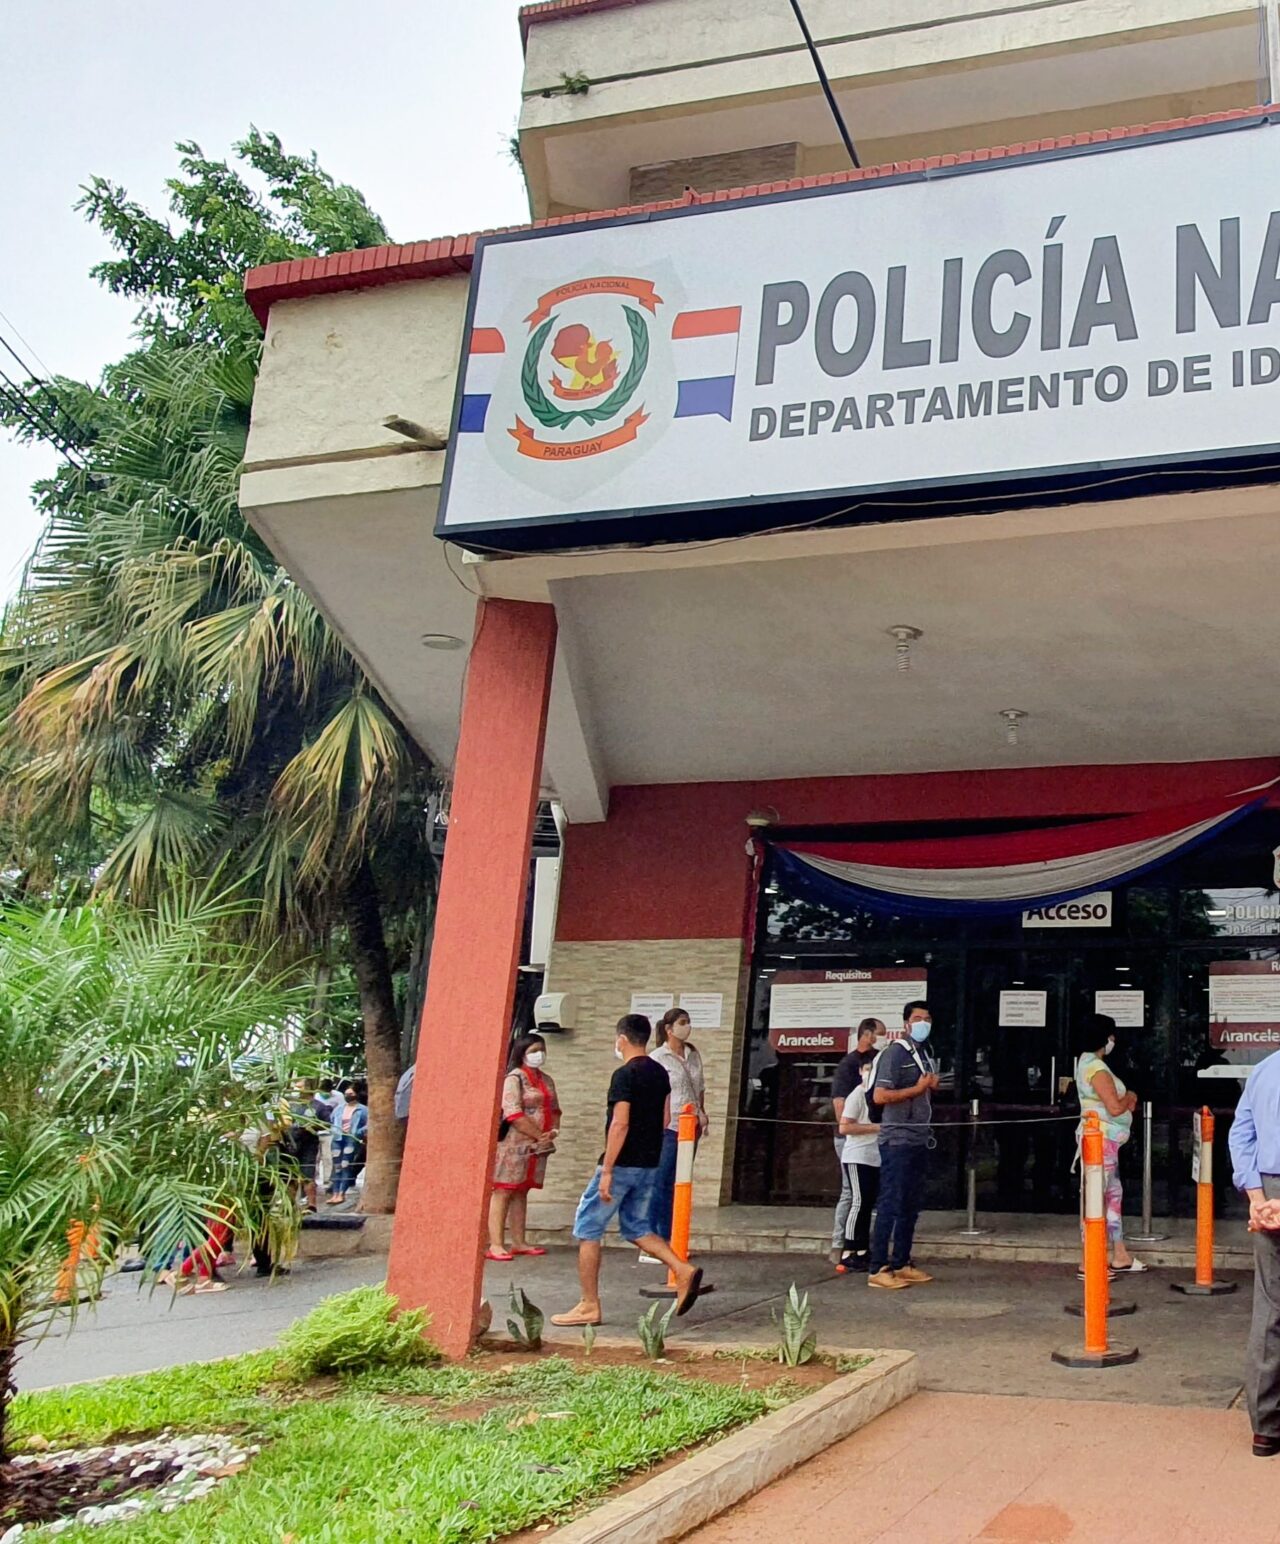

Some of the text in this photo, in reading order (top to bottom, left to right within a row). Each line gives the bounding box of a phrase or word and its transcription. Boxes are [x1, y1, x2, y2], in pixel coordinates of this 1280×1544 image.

[755, 215, 1138, 386] POLICÍA
[749, 365, 1128, 441] DEPARTAMENTO
[1148, 354, 1211, 397] DE
[543, 440, 603, 457] PARAGUAY
[825, 970, 872, 981] Requisitos
[777, 1034, 834, 1046] Aranceles
